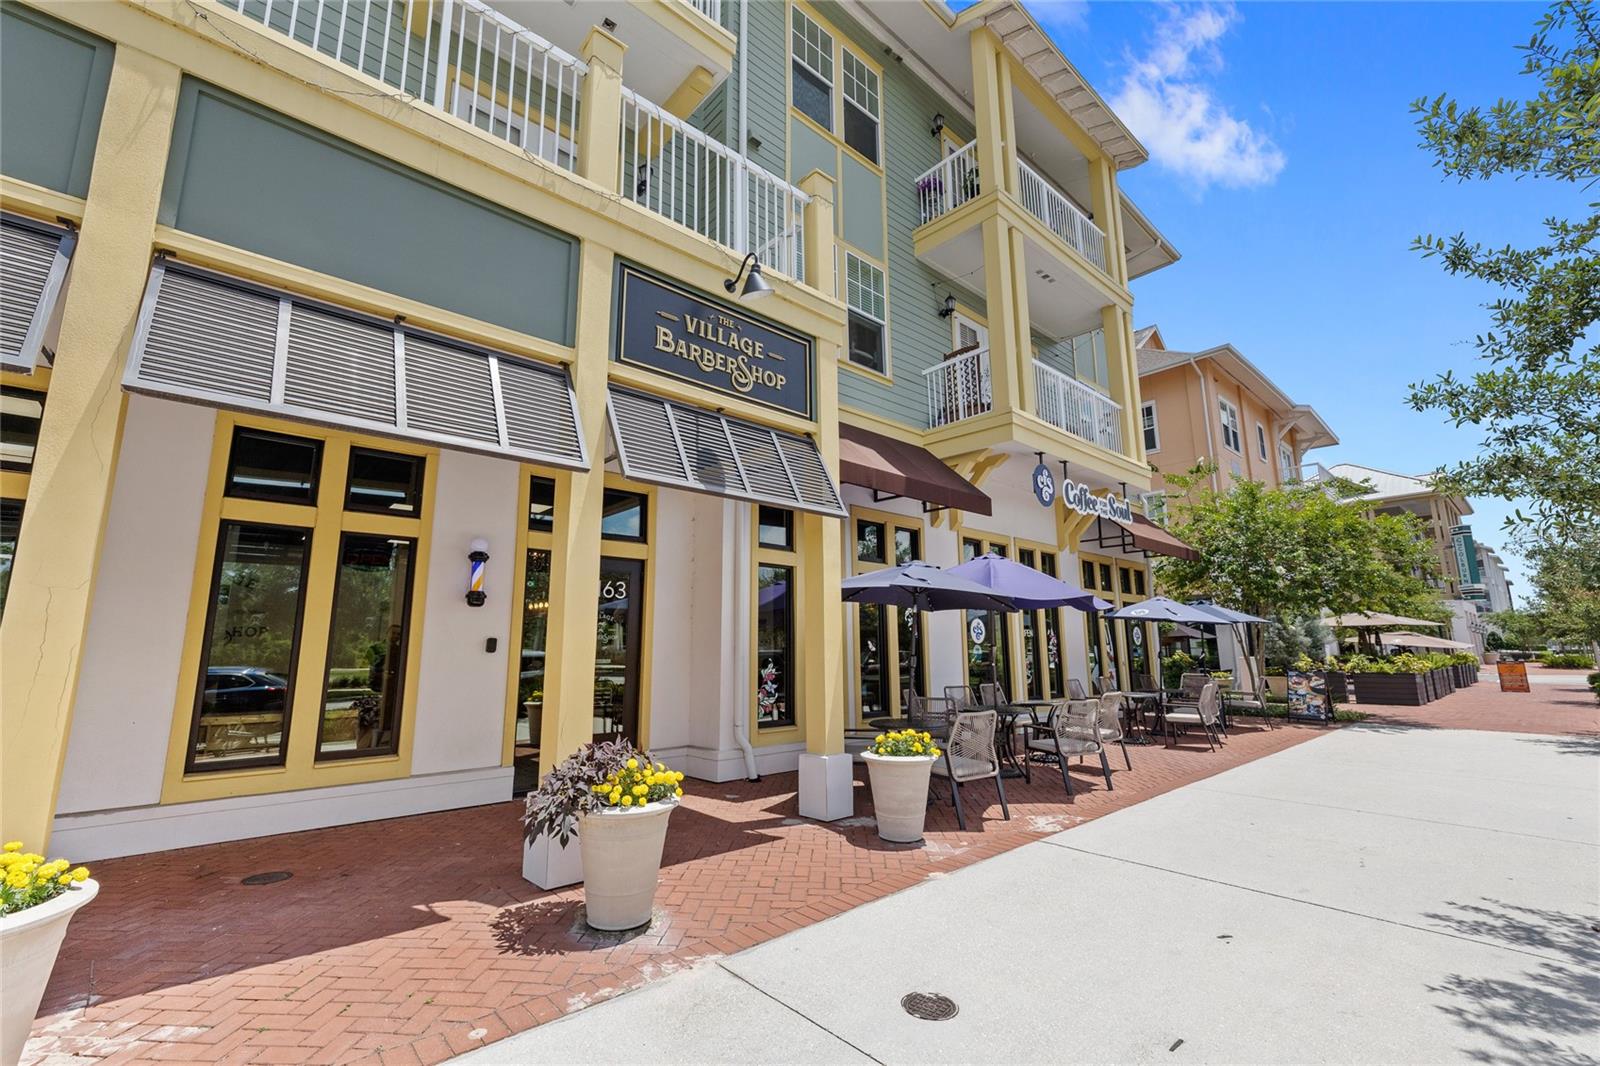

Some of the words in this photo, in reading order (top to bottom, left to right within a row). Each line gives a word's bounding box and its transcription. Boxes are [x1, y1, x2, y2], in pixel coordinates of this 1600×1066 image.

[684, 314, 763, 358] VILLAGE
[718, 315, 735, 328] THE
[655, 325, 786, 392] BARBERSHOP
[1064, 482, 1098, 513] Coffee
[1108, 495, 1131, 522] Soul
